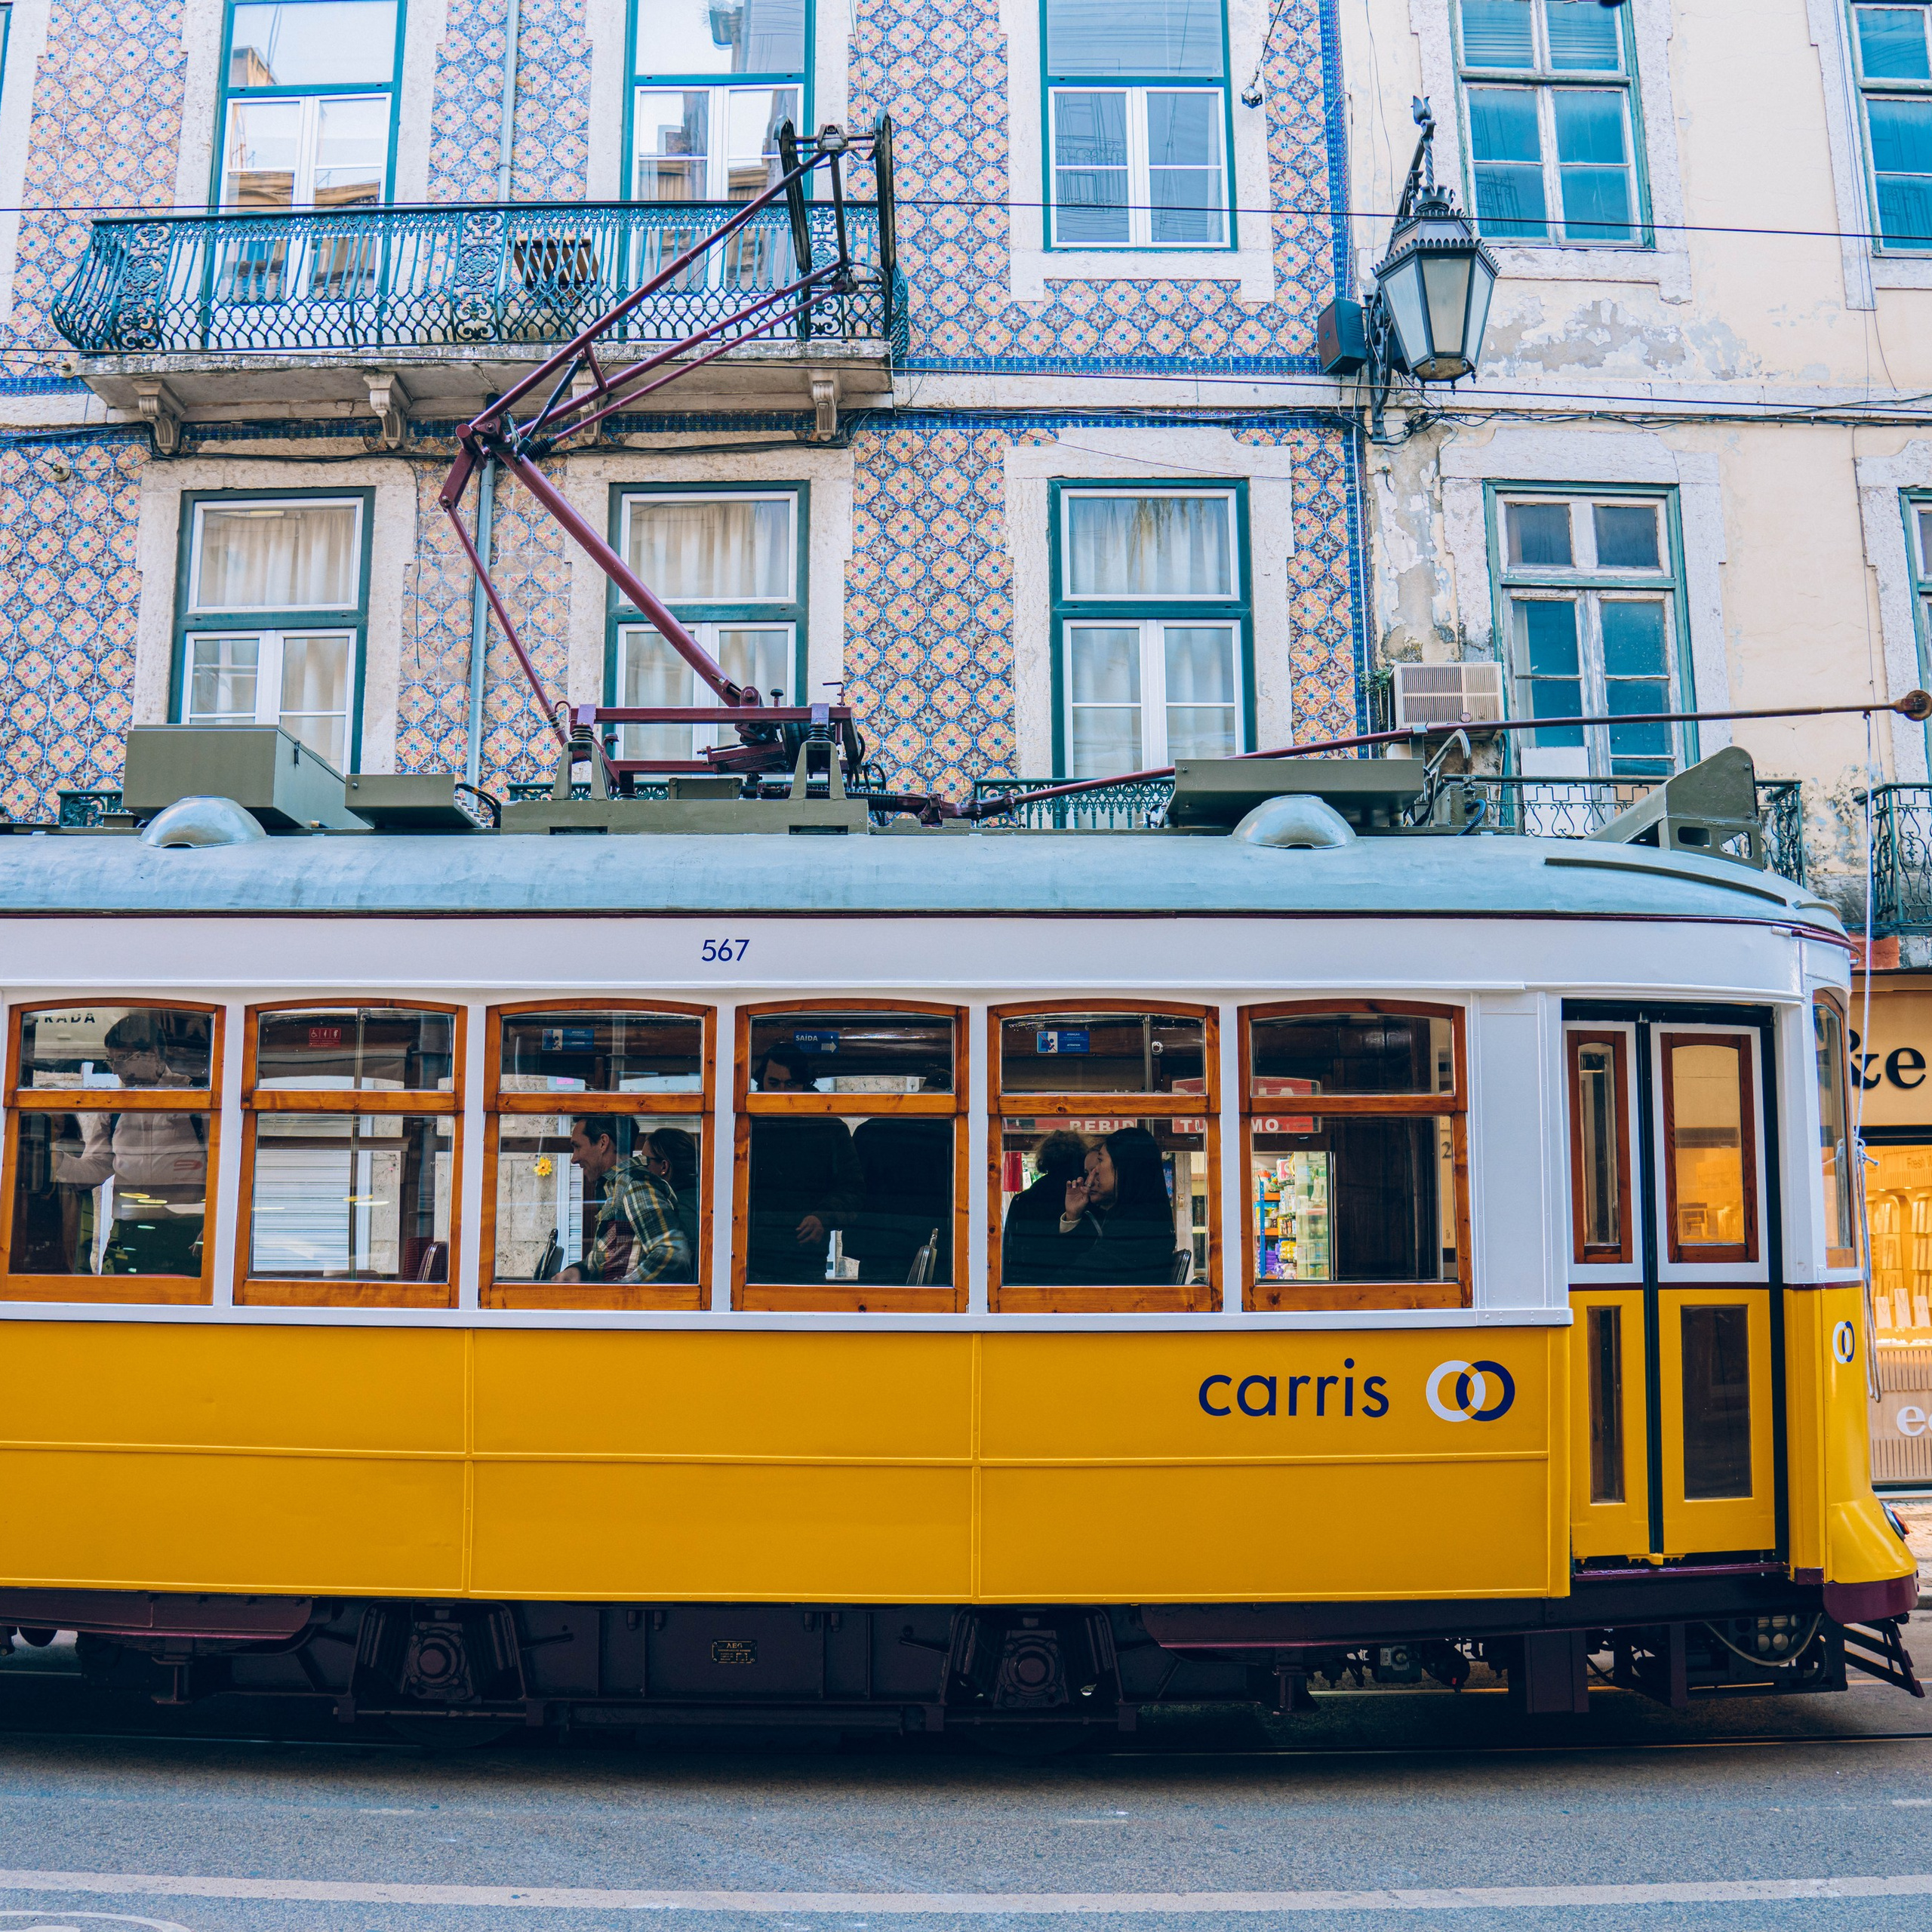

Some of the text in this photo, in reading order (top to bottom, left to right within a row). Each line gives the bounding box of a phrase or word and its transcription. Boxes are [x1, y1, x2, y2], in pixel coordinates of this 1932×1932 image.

[701, 938, 750, 962] 567
[1198, 1358, 1389, 1418] carris
[1896, 1406, 1932, 1437] e
